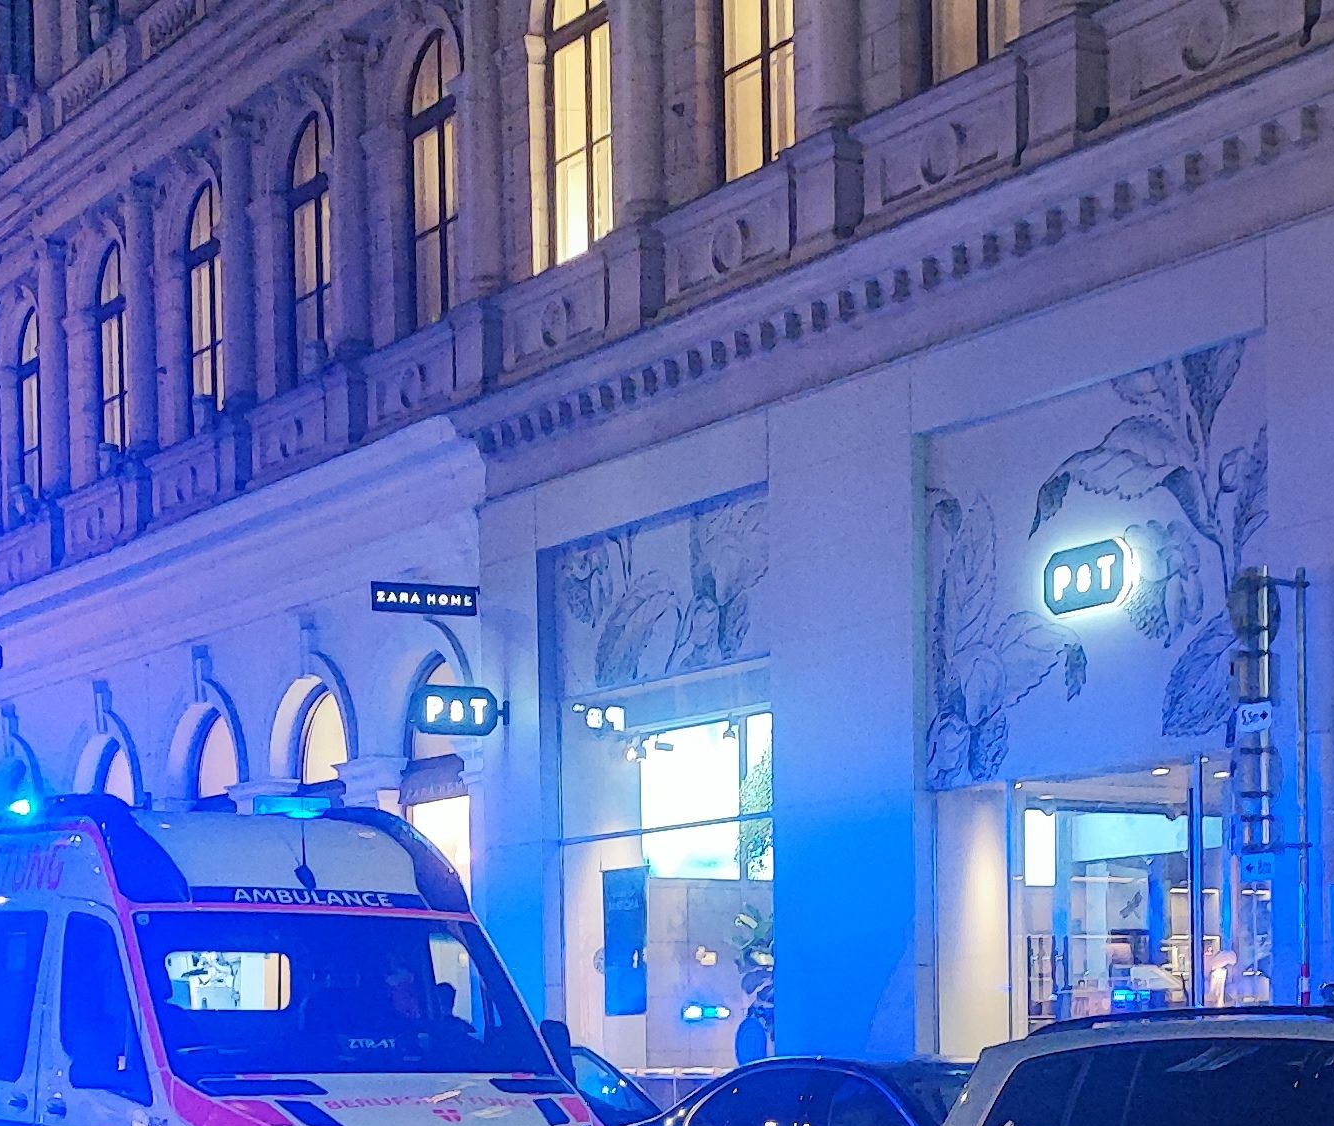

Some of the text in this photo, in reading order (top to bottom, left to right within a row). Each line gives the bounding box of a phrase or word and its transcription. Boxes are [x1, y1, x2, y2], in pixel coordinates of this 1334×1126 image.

[376, 591, 473, 607] ZARA HOME
[234, 888, 394, 908] AMBULANCE
